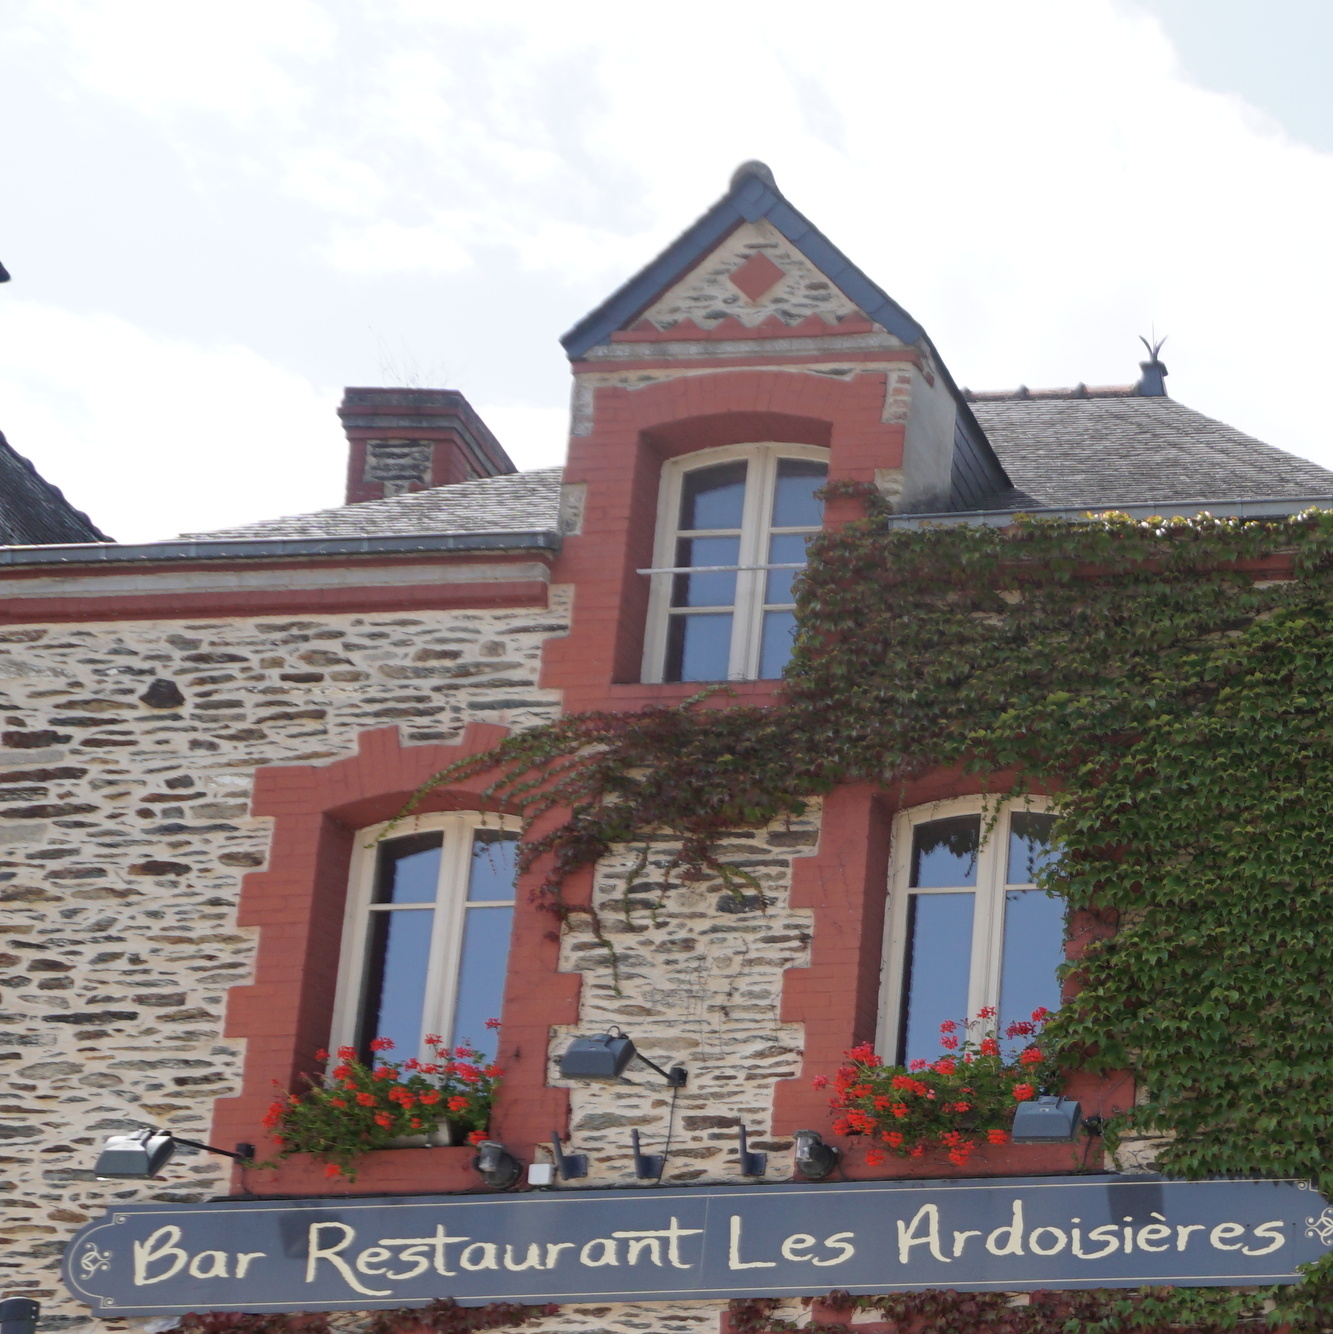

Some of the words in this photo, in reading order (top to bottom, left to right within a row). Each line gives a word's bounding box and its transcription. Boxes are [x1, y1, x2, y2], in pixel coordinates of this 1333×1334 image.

[133, 1224, 267, 1286] Bar
[305, 1216, 704, 1297] Restaurant
[728, 1215, 856, 1270] Les
[896, 1199, 1286, 1266] Ardoisières
